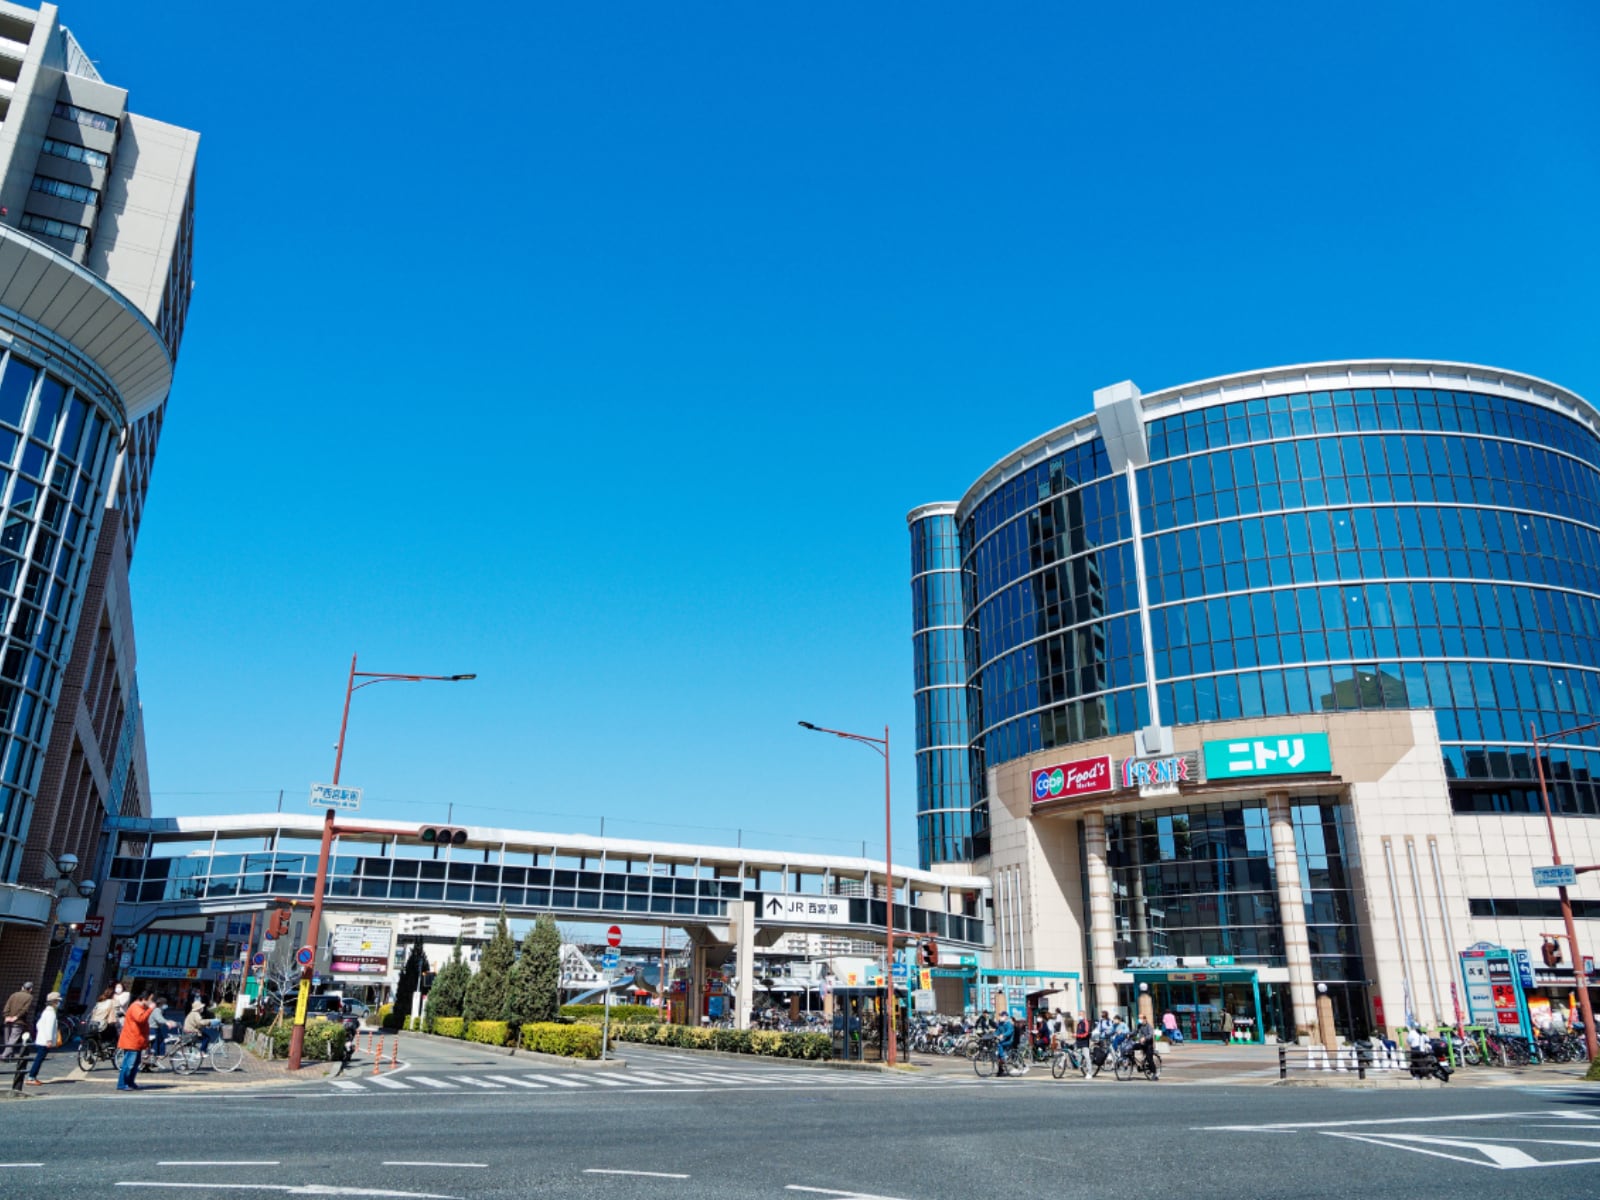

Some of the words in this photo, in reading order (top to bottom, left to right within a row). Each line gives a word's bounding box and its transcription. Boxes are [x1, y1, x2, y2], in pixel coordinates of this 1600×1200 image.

[1228, 738, 1306, 772] ニトリ
[1066, 762, 1106, 790] Food's
[788, 901, 804, 913] JR
[808, 902, 838, 915] 西宮駅
[83, 923, 100, 934] 24
